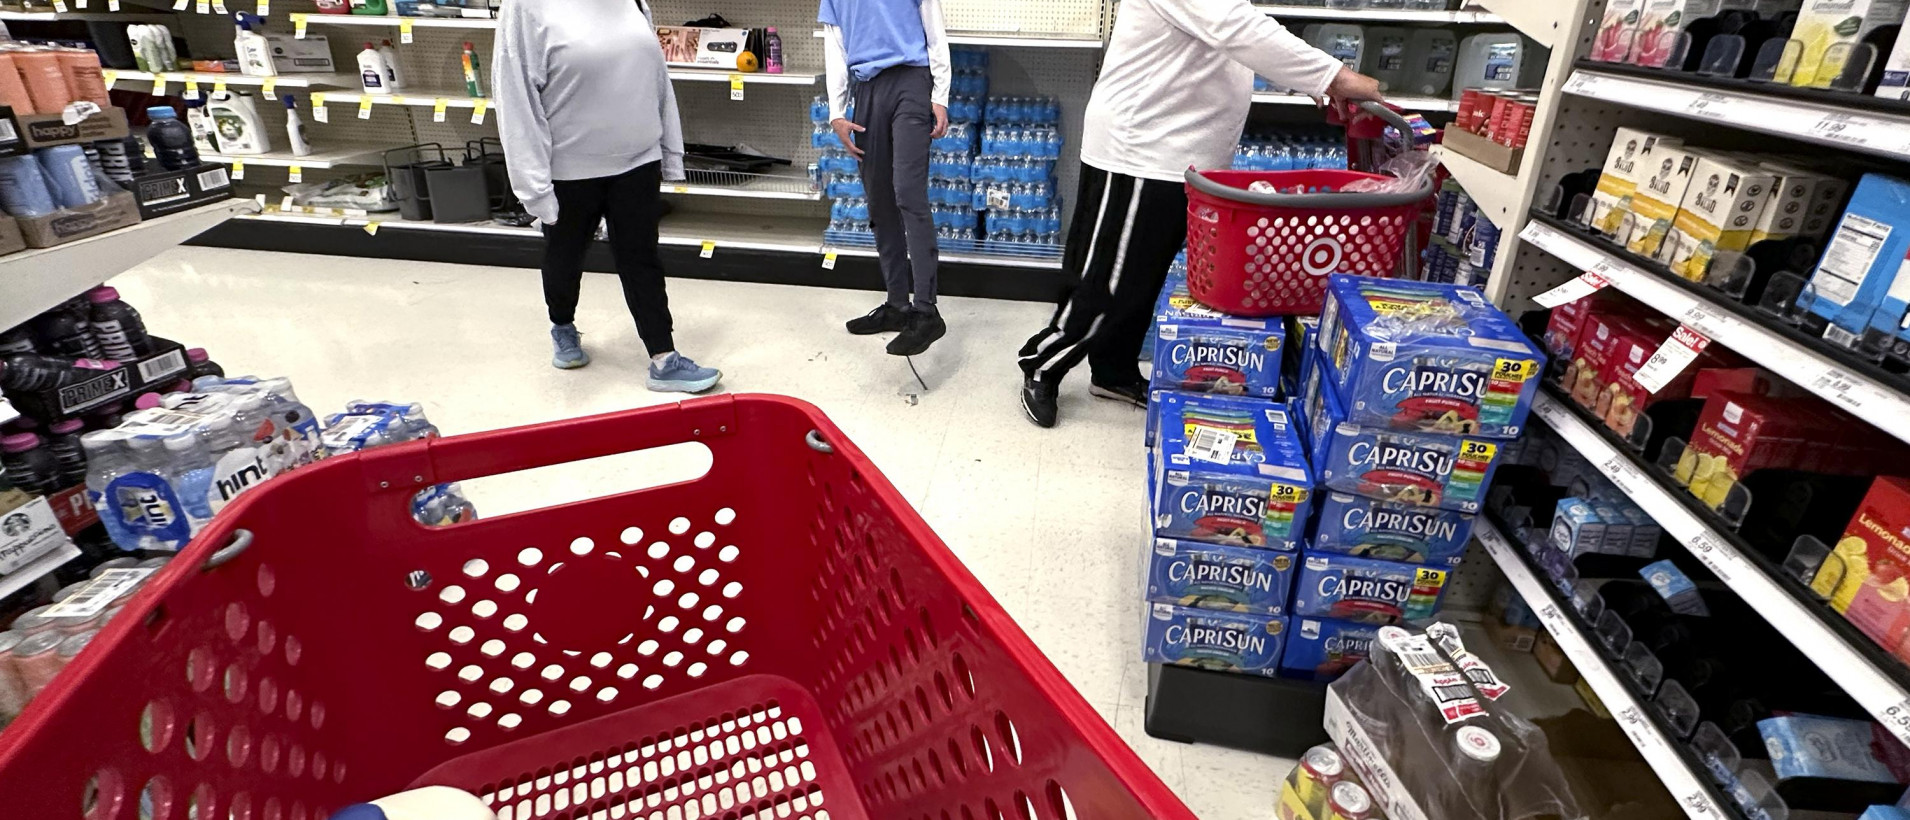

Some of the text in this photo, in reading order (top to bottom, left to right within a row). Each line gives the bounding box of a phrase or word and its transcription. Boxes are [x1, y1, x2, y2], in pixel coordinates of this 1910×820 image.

[32, 124, 76, 138] happy
[1814, 120, 1846, 132] 11.99
[1685, 308, 1706, 320] 9.99
[1672, 326, 1696, 348] Sale!
[1172, 344, 1264, 372] CAPRISUN
[1502, 362, 1522, 372] 30
[64, 372, 126, 408] PRIMEX
[1382, 368, 1488, 398] CAPRISU
[1502, 426, 1519, 435] 10
[1702, 422, 1744, 456] Lemonade
[1348, 442, 1453, 476] CAPRISU
[1466, 443, 1487, 453] 30
[1604, 460, 1621, 474] 2.49
[216, 456, 268, 502] hint
[1276, 485, 1294, 495] 30
[1180, 491, 1268, 518] CAPRISU
[1462, 502, 1478, 510] 10
[1344, 508, 1456, 542] CAPRISUN
[1859, 513, 1910, 555] Lemonad
[1692, 536, 1713, 554] 6.59
[1168, 561, 1272, 592] CAPRISUN
[1421, 571, 1438, 579] 30
[1318, 576, 1411, 602] CAPRISU
[1165, 625, 1265, 655] CAPRISUN
[1324, 637, 1370, 652] CAPRI
